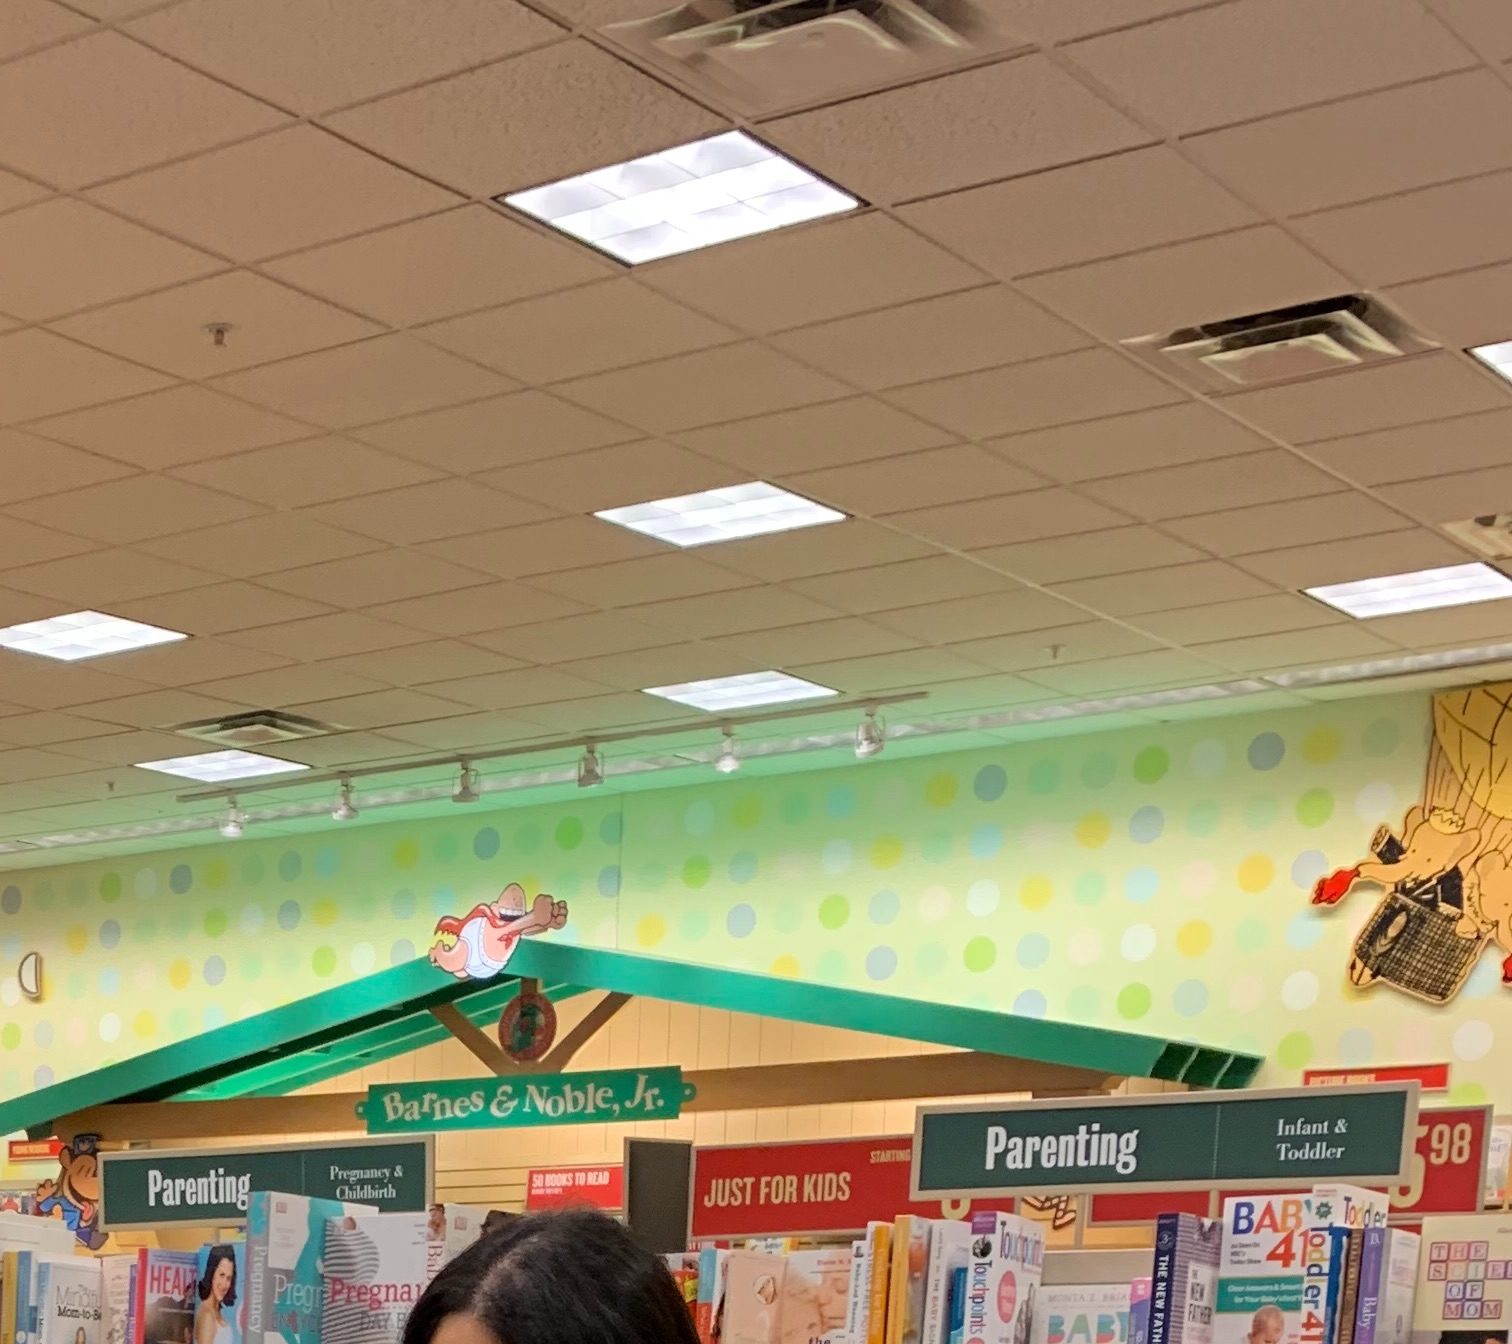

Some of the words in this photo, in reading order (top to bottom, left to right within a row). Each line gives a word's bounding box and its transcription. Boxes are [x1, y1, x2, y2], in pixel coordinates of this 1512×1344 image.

[382, 1089, 486, 1122] Barnes
[490, 1085, 518, 1118] &
[522, 1082, 620, 1118] Noble,
[624, 1074, 665, 1112] Jr.
[1277, 1119, 1329, 1137] Infant
[1335, 1118, 1348, 1134] &
[870, 1149, 911, 1164] STARTING
[986, 1123, 1139, 1174] Parenting
[1277, 1143, 1345, 1161] Toddler
[330, 1165, 389, 1184] Pregnancy
[393, 1165, 403, 1177] &
[545, 1173, 573, 1187] BOOKS
[575, 1172, 586, 1185] TO
[587, 1171, 609, 1185] READ
[147, 1168, 251, 1211] Parenting
[336, 1186, 397, 1201] Childbirth
[703, 1177, 755, 1208] JUST
[759, 1174, 798, 1205] FOR
[803, 1172, 852, 1202] KIDS
[1431, 1242, 1488, 1262] THE
[1158, 1255, 1170, 1278] THE
[1304, 1222, 1335, 1309] Toddler
[249, 1246, 267, 1334] Pregnancy
[969, 1260, 992, 1335] Touchpoints
[1155, 1281, 1167, 1309] NEW
[1445, 1281, 1484, 1299] OF
[931, 1296, 940, 1321] BABY
[1443, 1300, 1502, 1320] MOM
[1047, 1312, 1129, 1344] BABY
